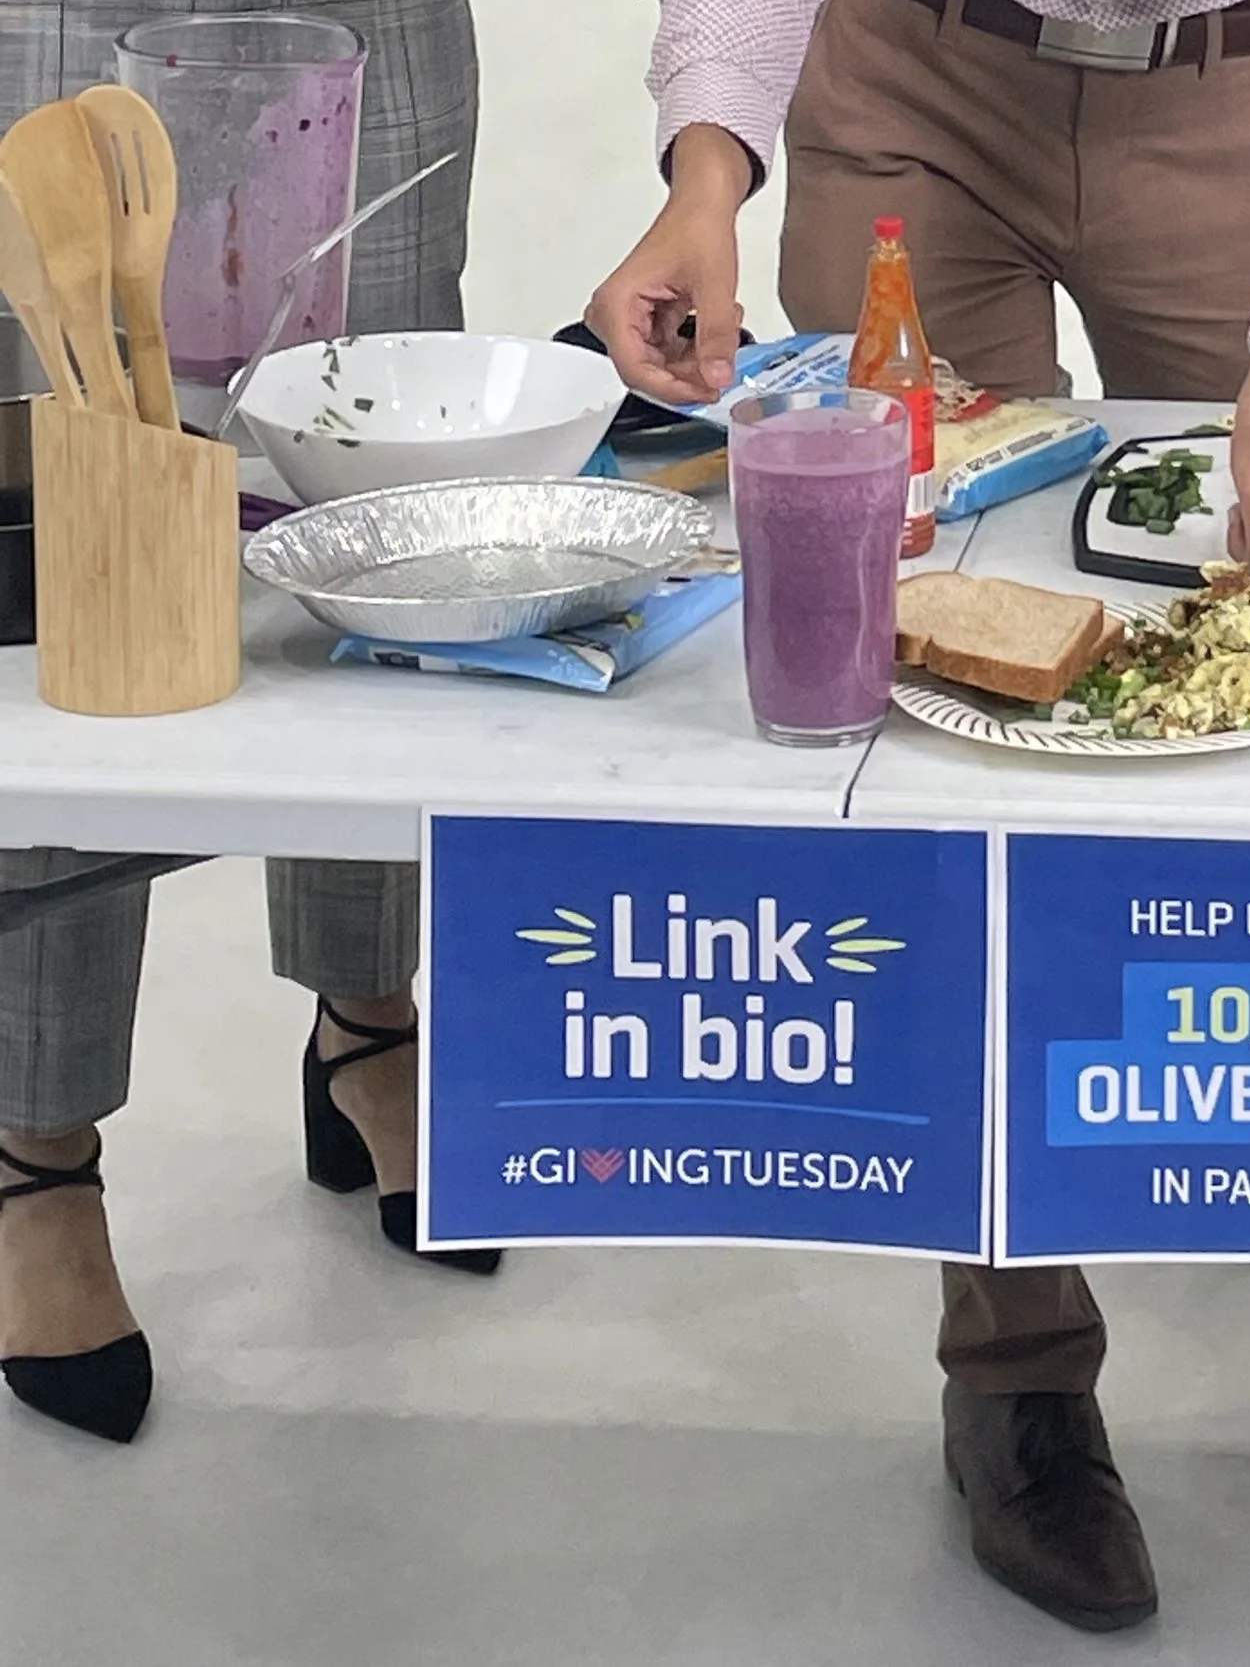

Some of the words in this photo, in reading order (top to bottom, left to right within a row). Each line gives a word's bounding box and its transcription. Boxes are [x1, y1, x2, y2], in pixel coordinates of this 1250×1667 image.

[612, 893, 815, 984] Link
[1130, 898, 1235, 938] HELP
[564, 989, 649, 1080] in
[681, 992, 855, 1086] bio!
[1152, 1167, 1191, 1205] IN
